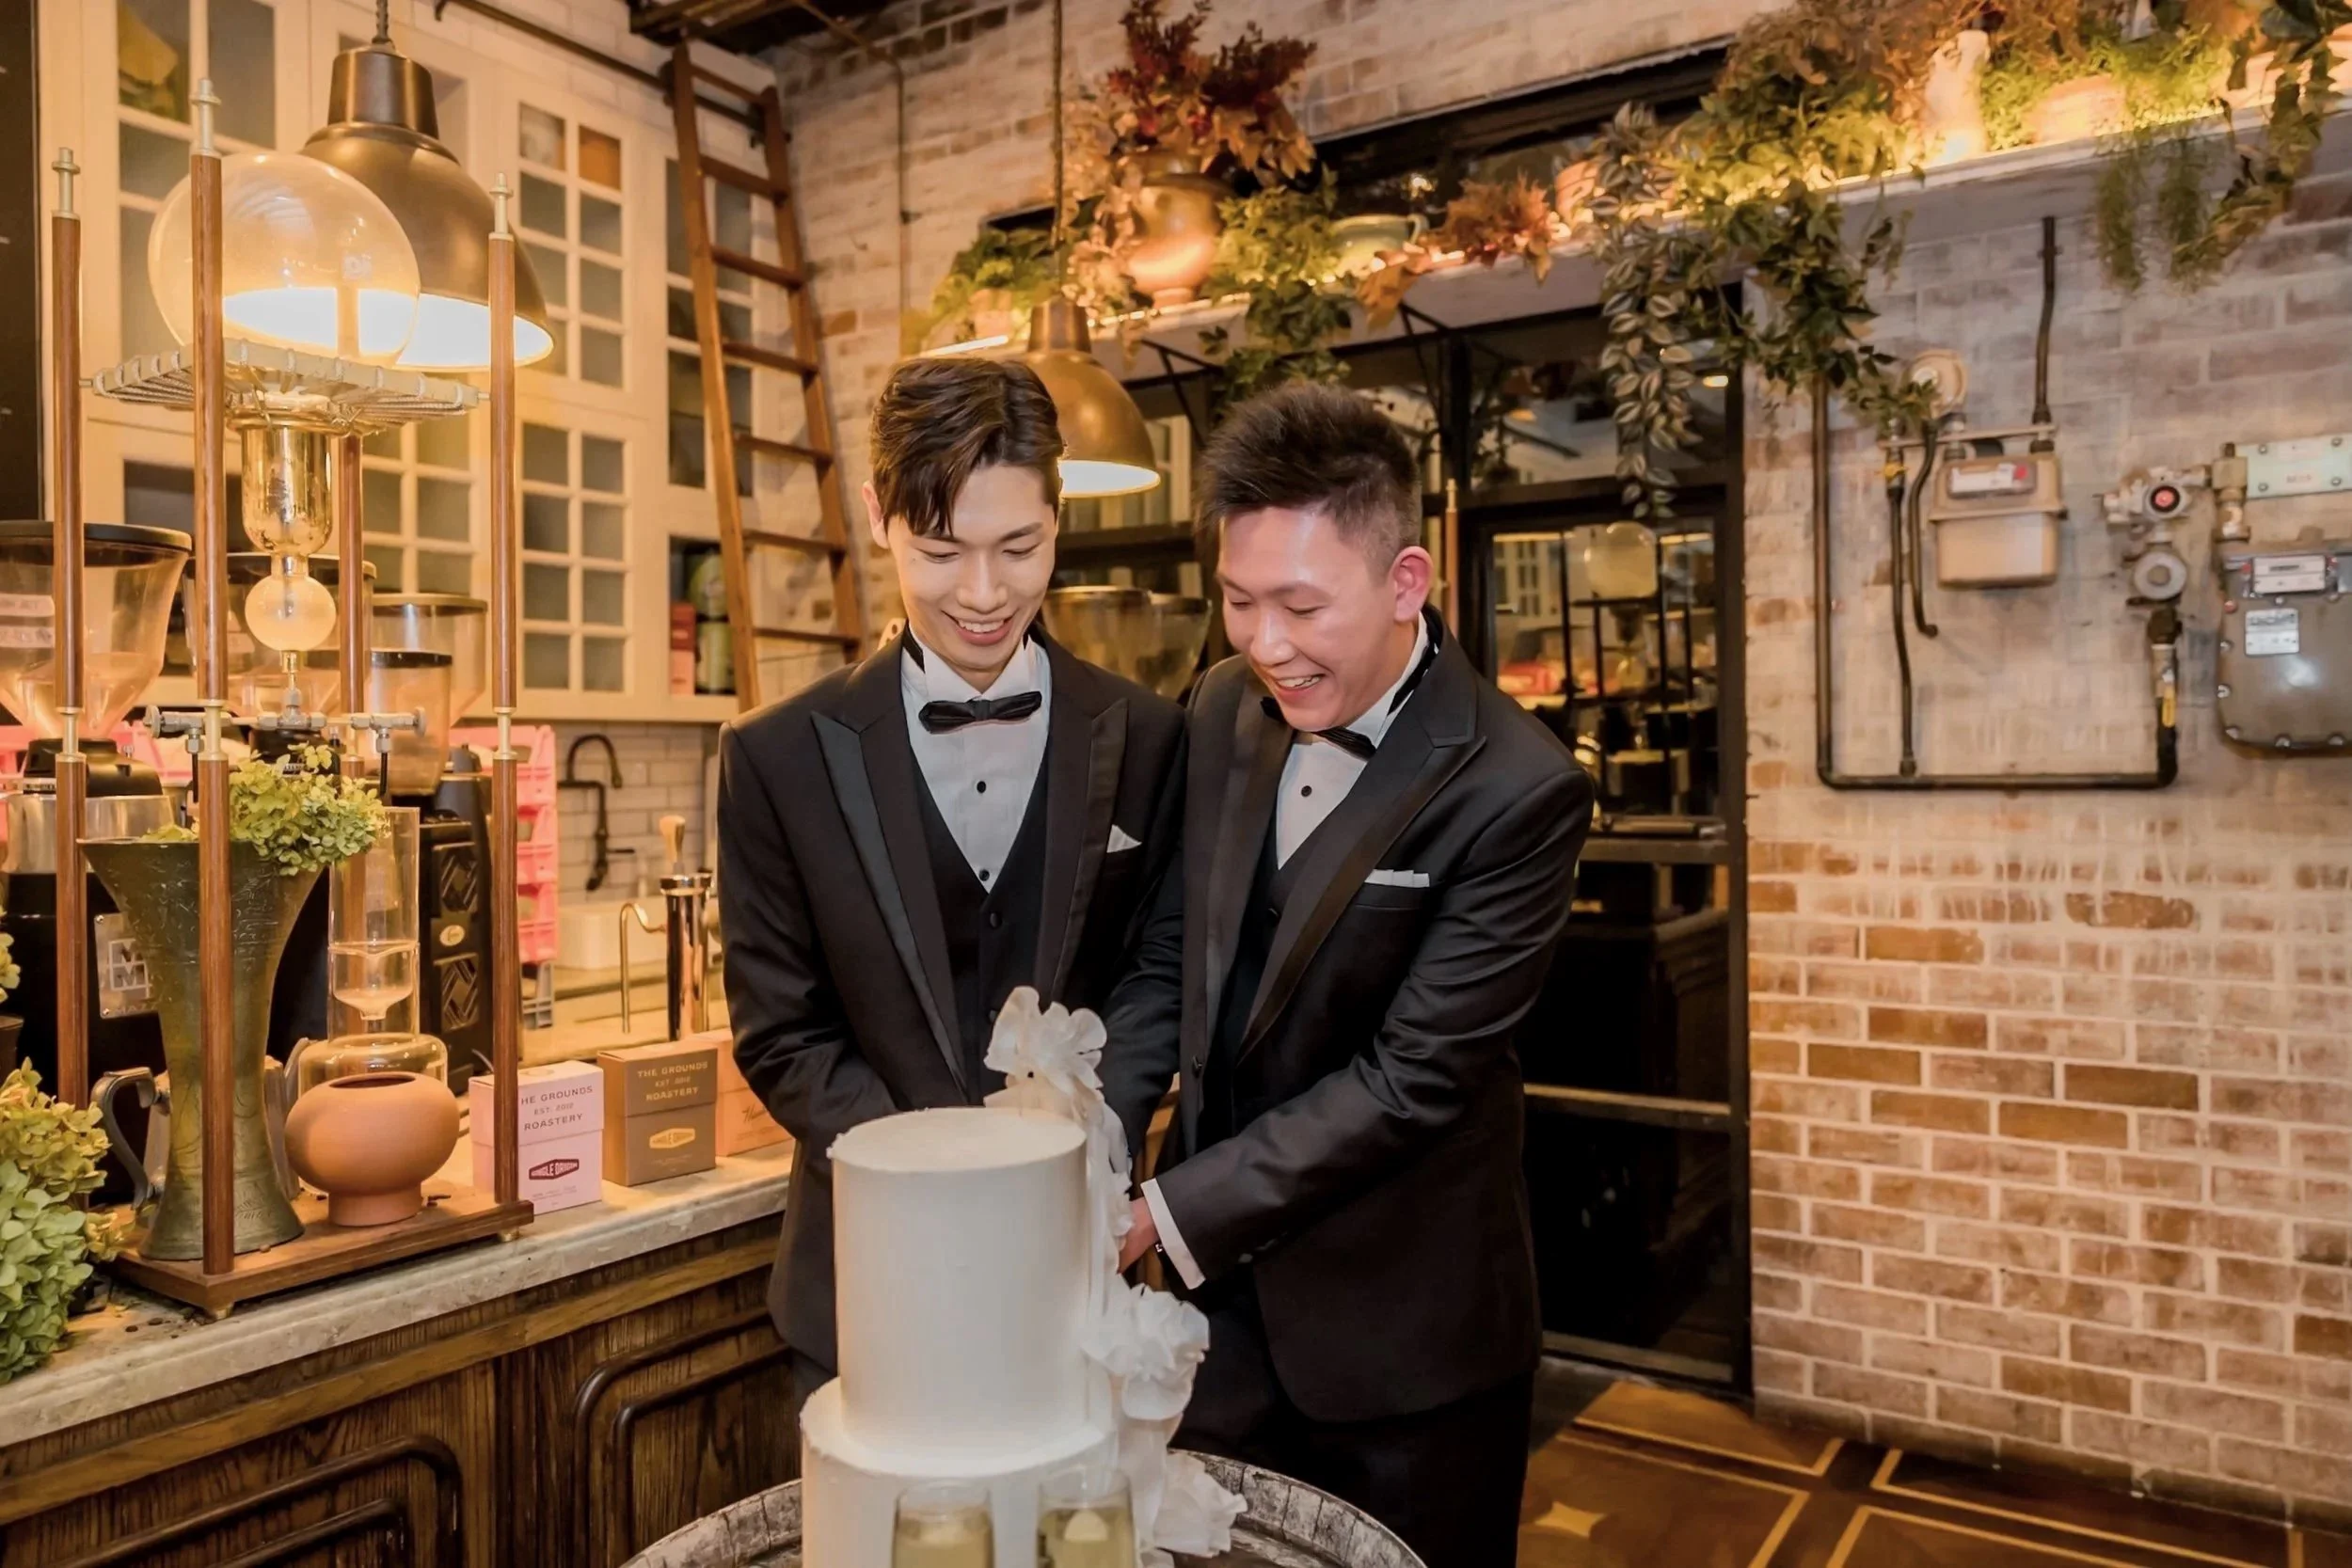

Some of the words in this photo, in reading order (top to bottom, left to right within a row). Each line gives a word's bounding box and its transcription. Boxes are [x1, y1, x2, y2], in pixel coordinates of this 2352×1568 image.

[637, 1069, 658, 1078] THE
[661, 1061, 708, 1075] GROUNDS
[521, 1095, 536, 1105] HE
[540, 1085, 594, 1102] GROUNDS
[645, 1086, 699, 1101] ROASTERY
[524, 1113, 583, 1132] ROASTERY
